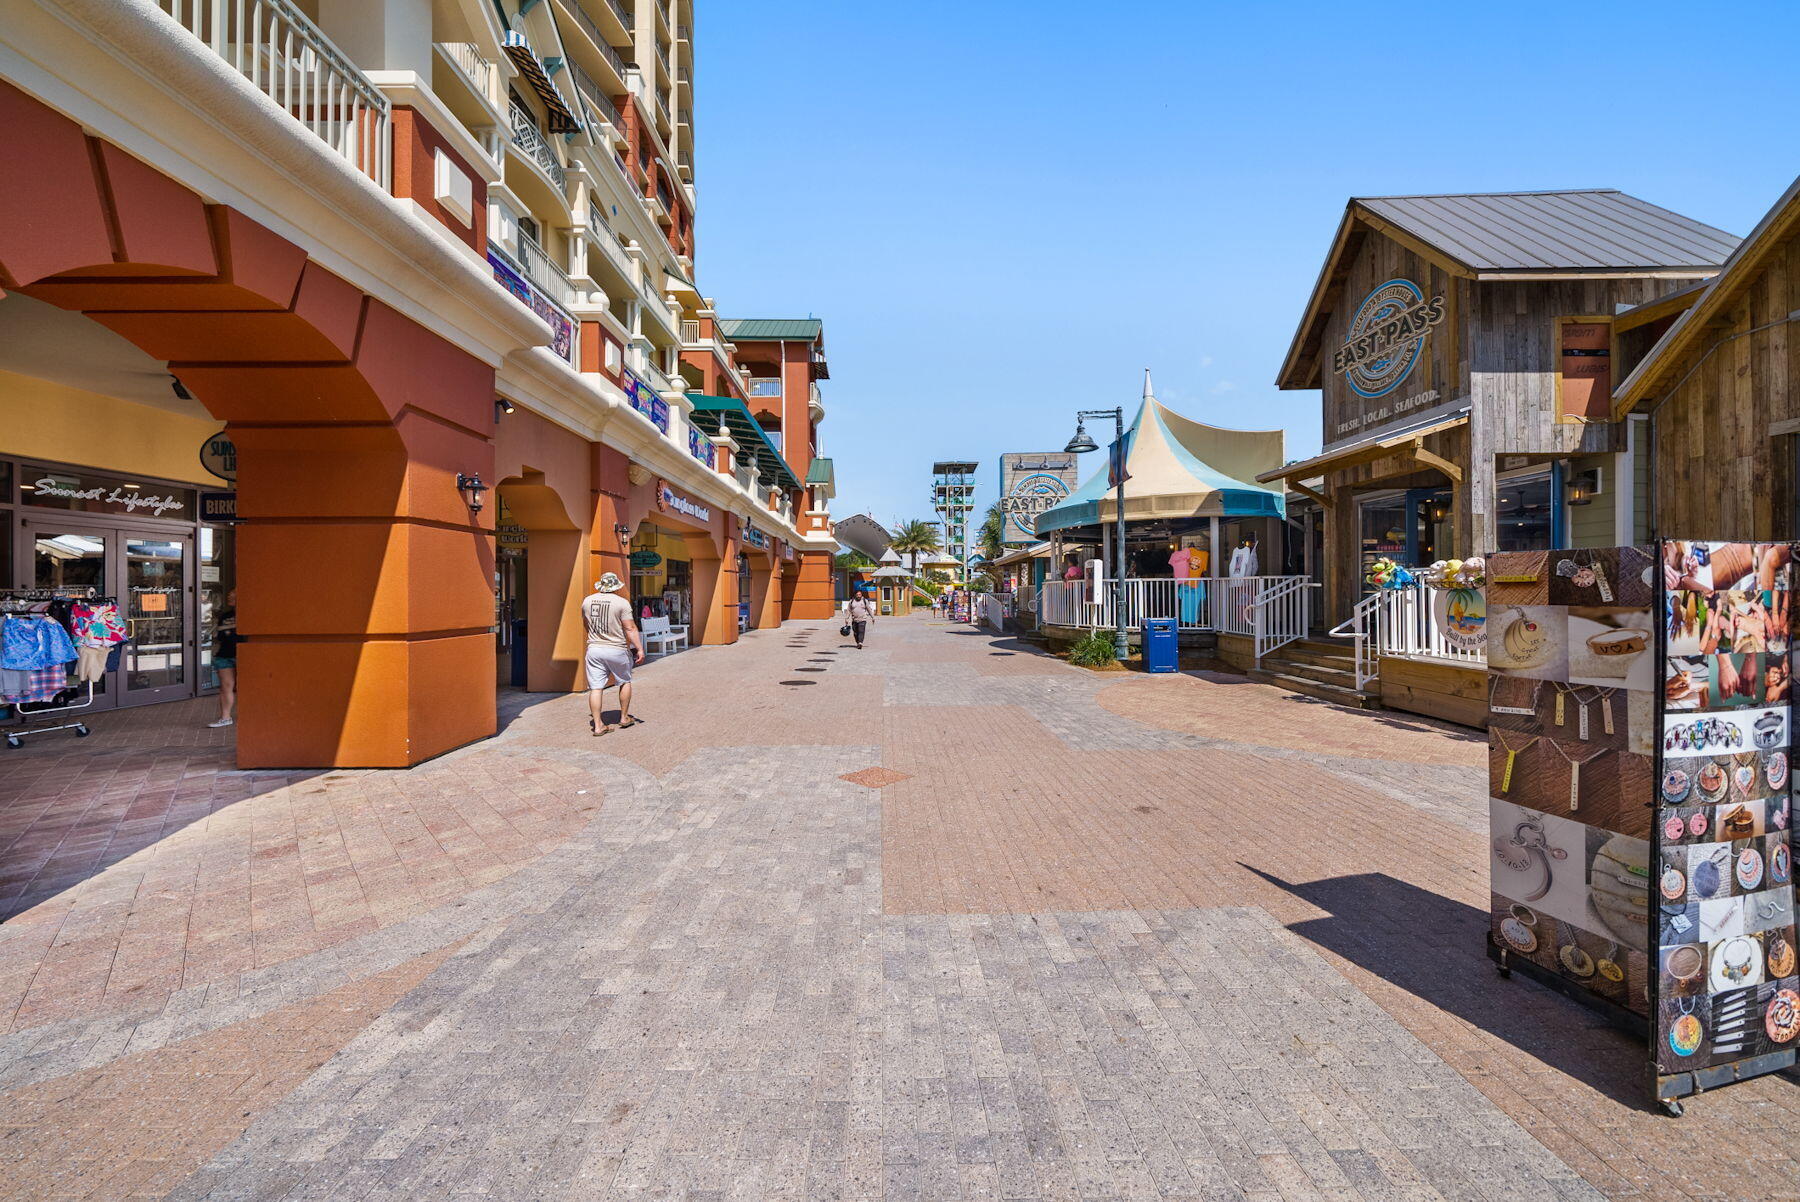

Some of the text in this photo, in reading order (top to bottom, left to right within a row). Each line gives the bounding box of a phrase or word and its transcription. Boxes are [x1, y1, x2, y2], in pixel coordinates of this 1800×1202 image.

[1334, 296, 1446, 374] EAST PASS
[1337, 389, 1440, 435] FRESH. LOCAL. SEAFOOD.
[34, 478, 184, 516] Sunset Lifestyles
[1000, 497, 1038, 512] EAST
[1446, 629, 1488, 648] Built by the Sea
